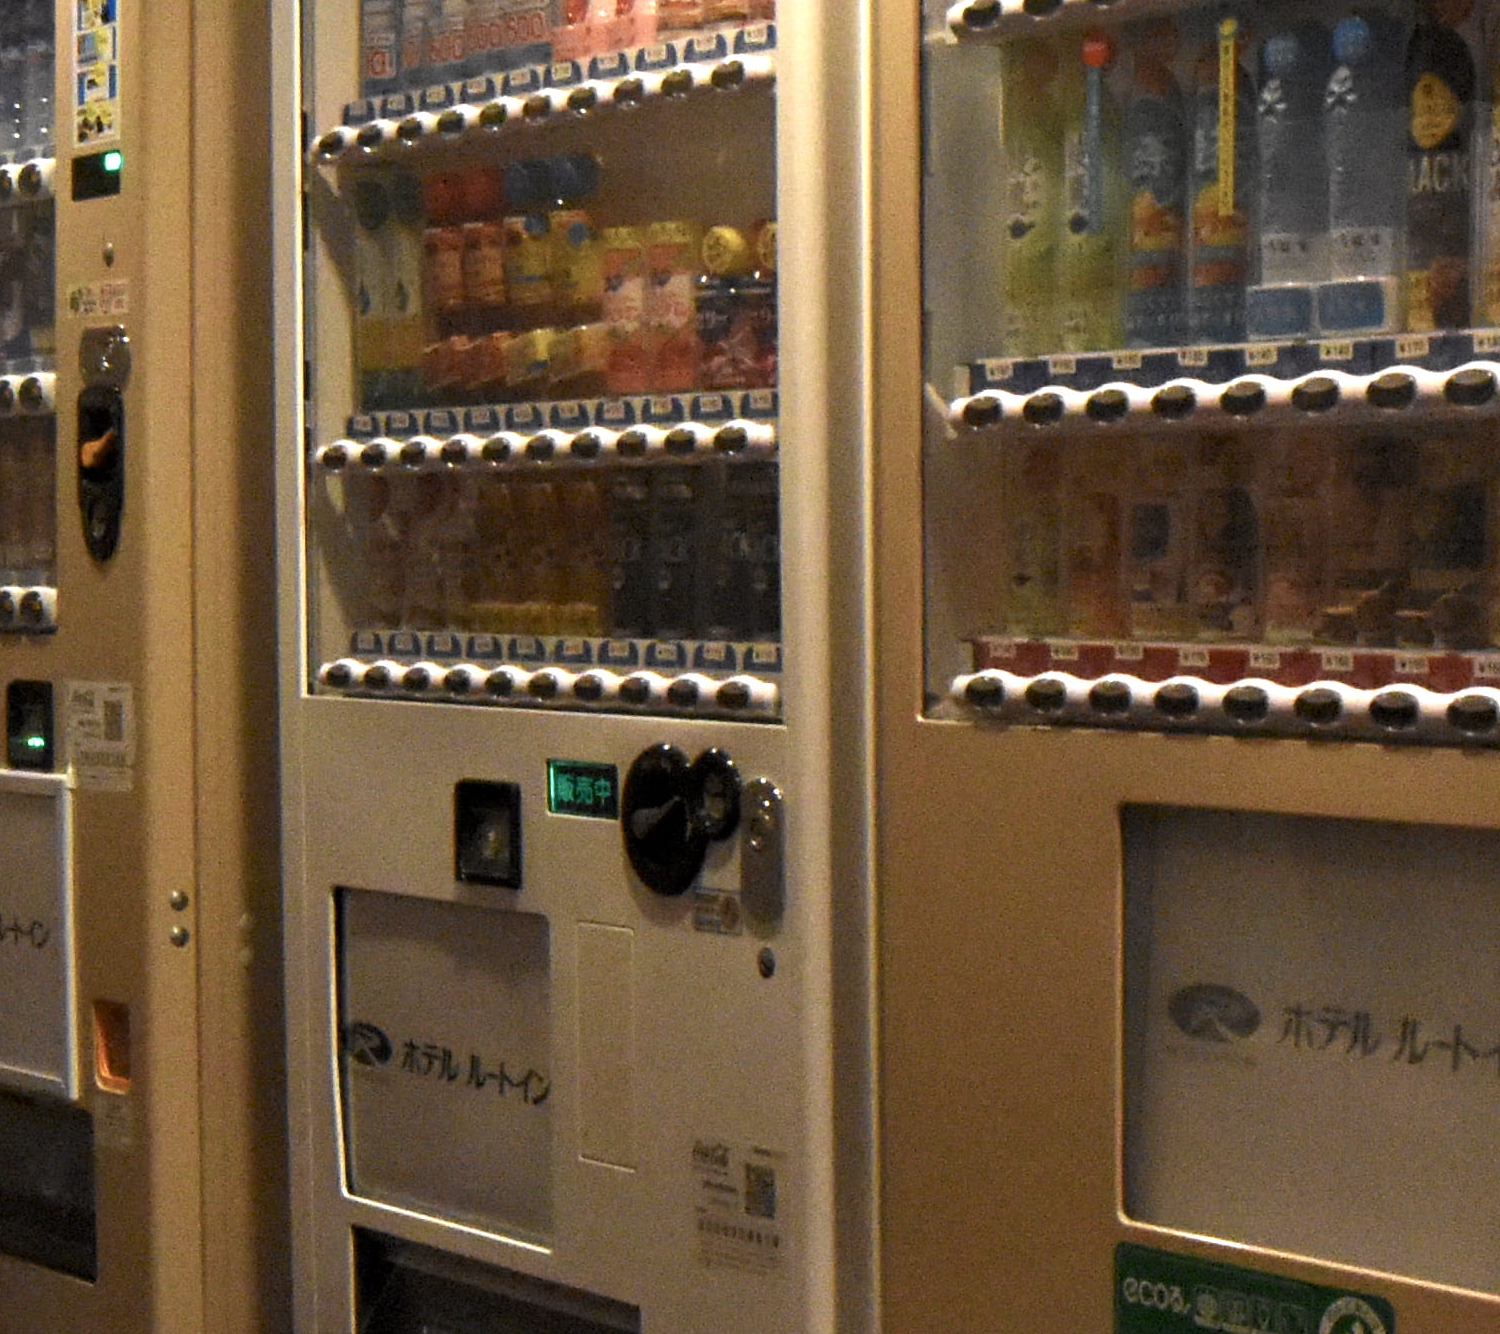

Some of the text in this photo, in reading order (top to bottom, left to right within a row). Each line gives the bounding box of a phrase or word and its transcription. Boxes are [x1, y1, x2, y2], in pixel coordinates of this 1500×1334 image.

[1278, 1004, 1381, 1059] ホテル
[402, 1037, 460, 1083] ホテル
